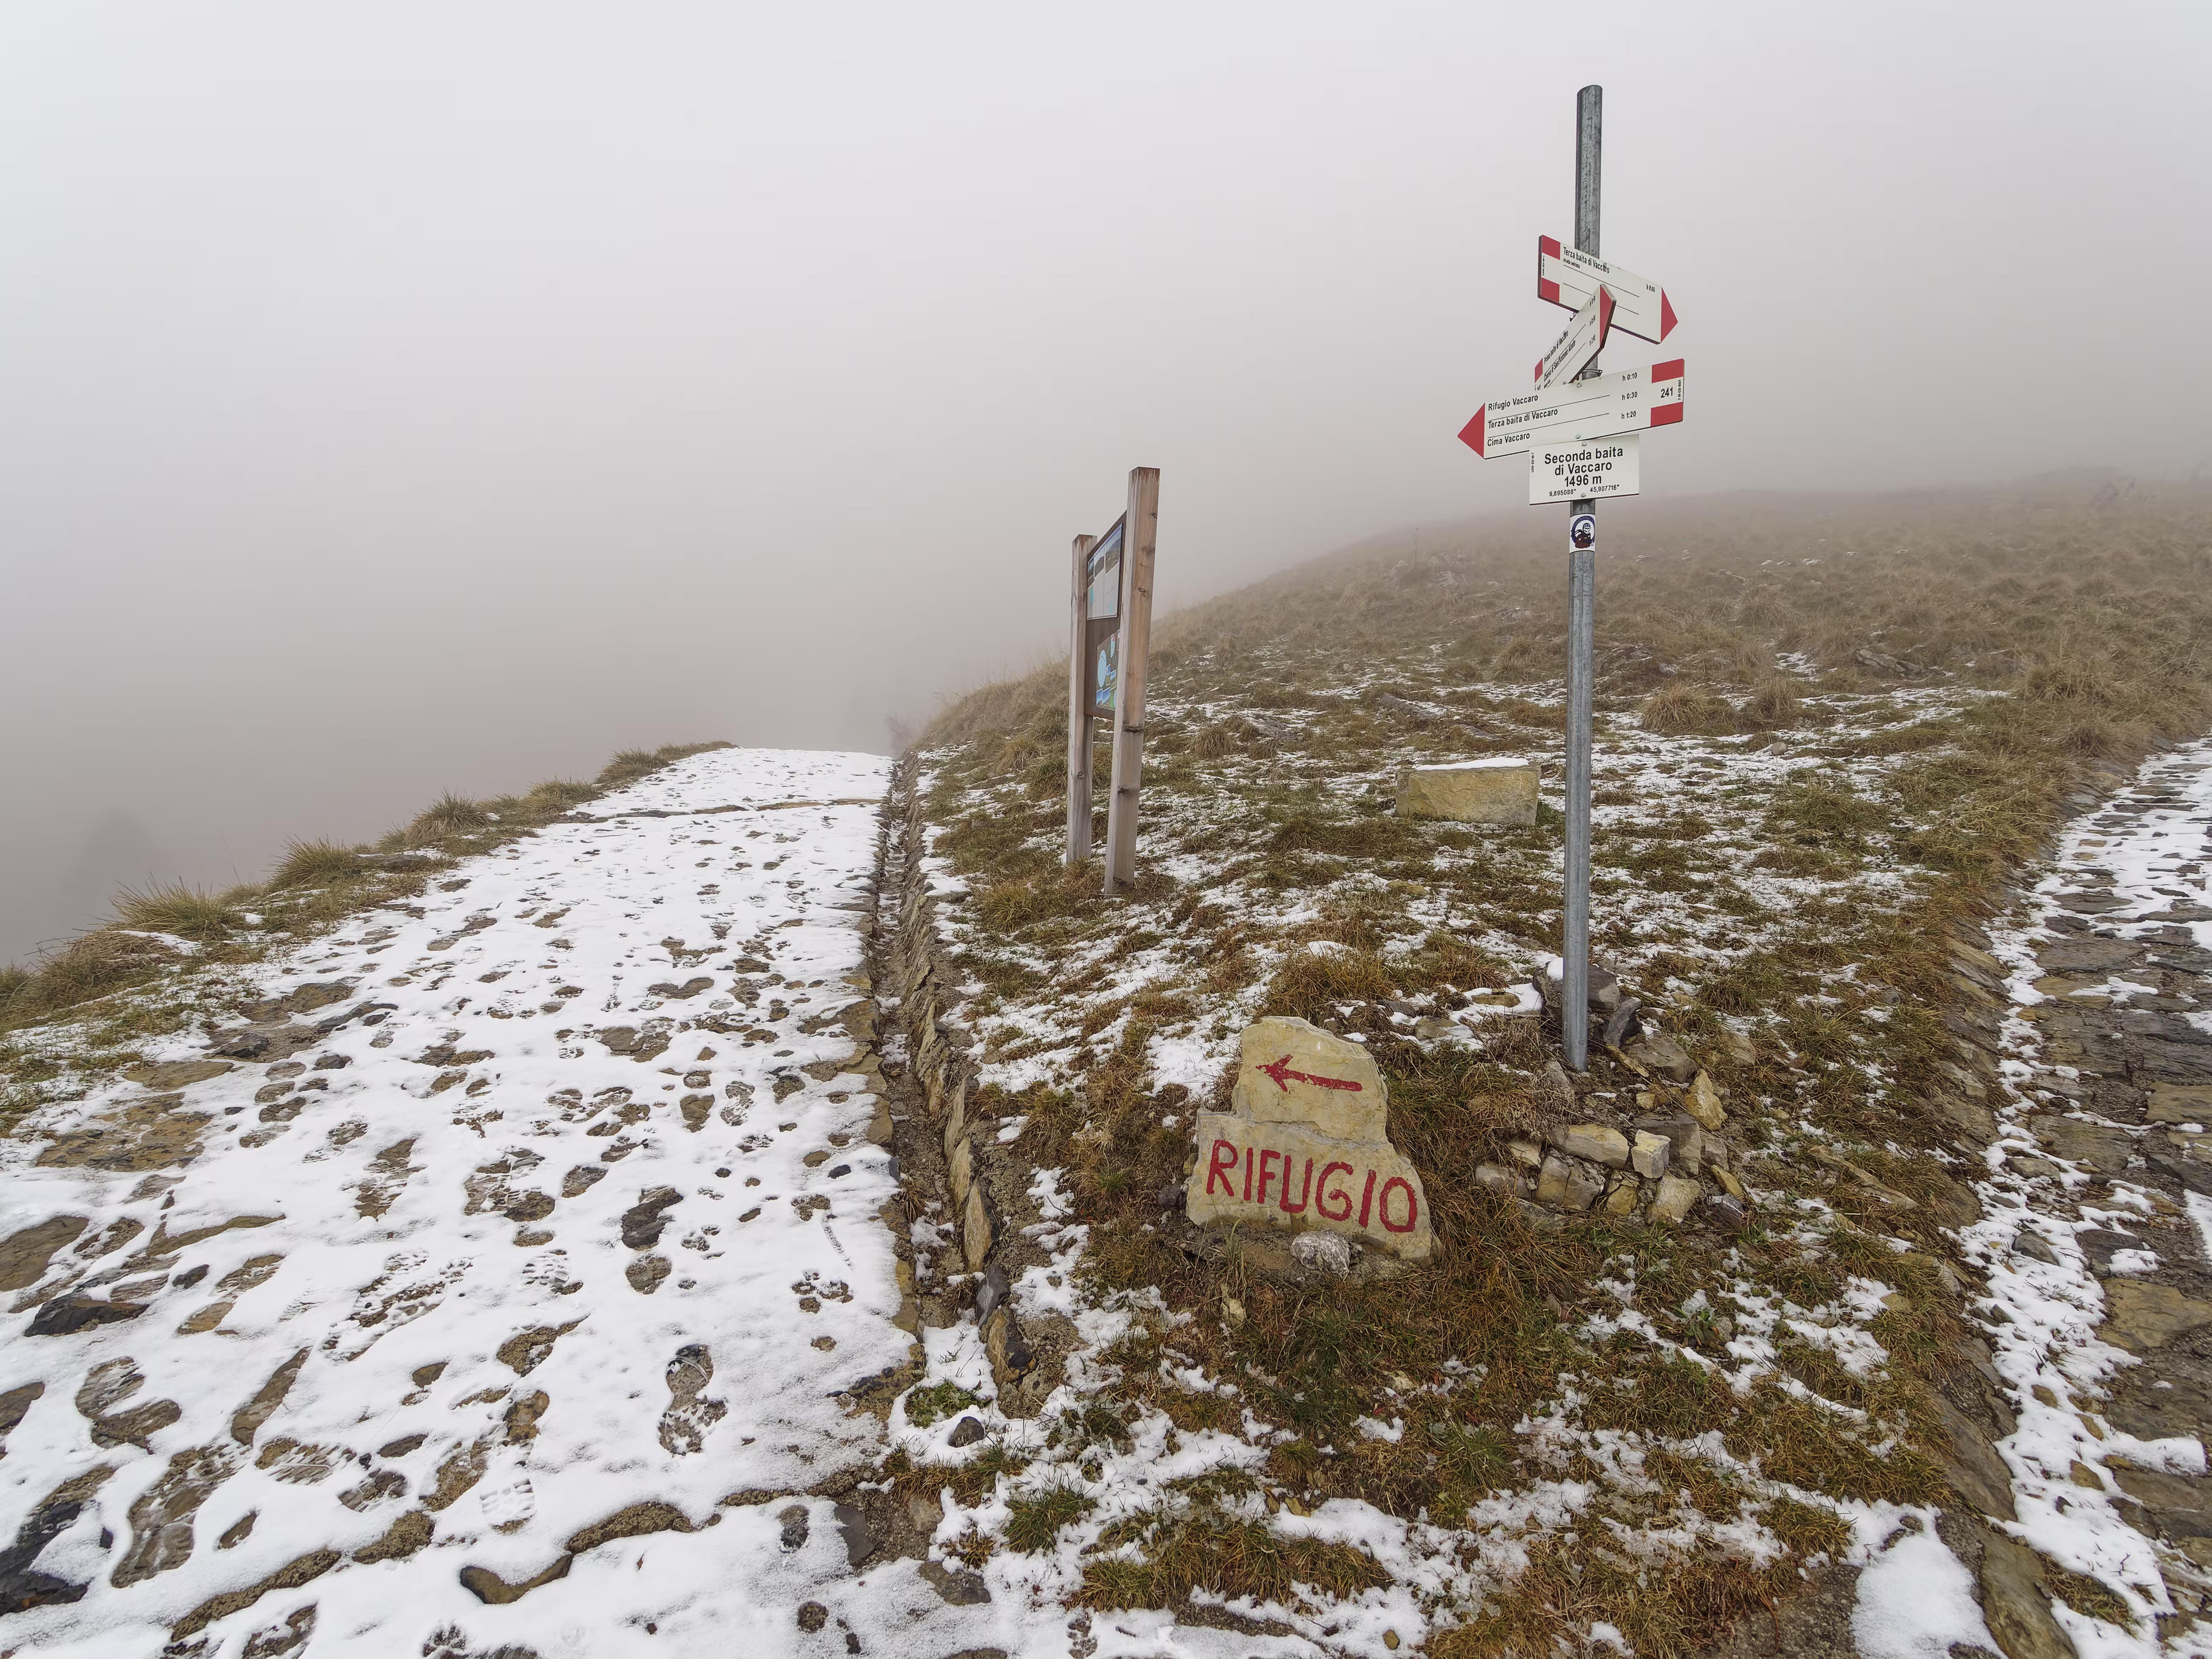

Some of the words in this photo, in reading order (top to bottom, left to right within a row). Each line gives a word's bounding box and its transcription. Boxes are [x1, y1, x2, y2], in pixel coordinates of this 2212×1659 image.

[1563, 246, 1575, 259] Terza
[1576, 252, 1587, 264] baita
[1588, 258, 1592, 266] di
[1593, 259, 1610, 274] Vaccaro
[1627, 372, 1637, 380] 0:10
[1627, 391, 1638, 399] 0:30
[1661, 387, 1673, 398] 241
[1488, 400, 1511, 411] Rifugio
[1513, 395, 1538, 406] Vaccaro
[1488, 420, 1505, 429] Terza
[1506, 416, 1522, 425] baita
[1532, 409, 1558, 420] Vaccaro
[1487, 438, 1502, 446] Cima
[1505, 433, 1530, 443] Vaccaro
[1544, 449, 1592, 464] Seconda
[1595, 446, 1623, 459] baita
[1554, 464, 1564, 476] di
[1568, 462, 1612, 474] Vaccaro
[1564, 474, 1589, 487] 1496
[1592, 475, 1602, 484] m
[1206, 1139, 1417, 1233] RIFUGIO
